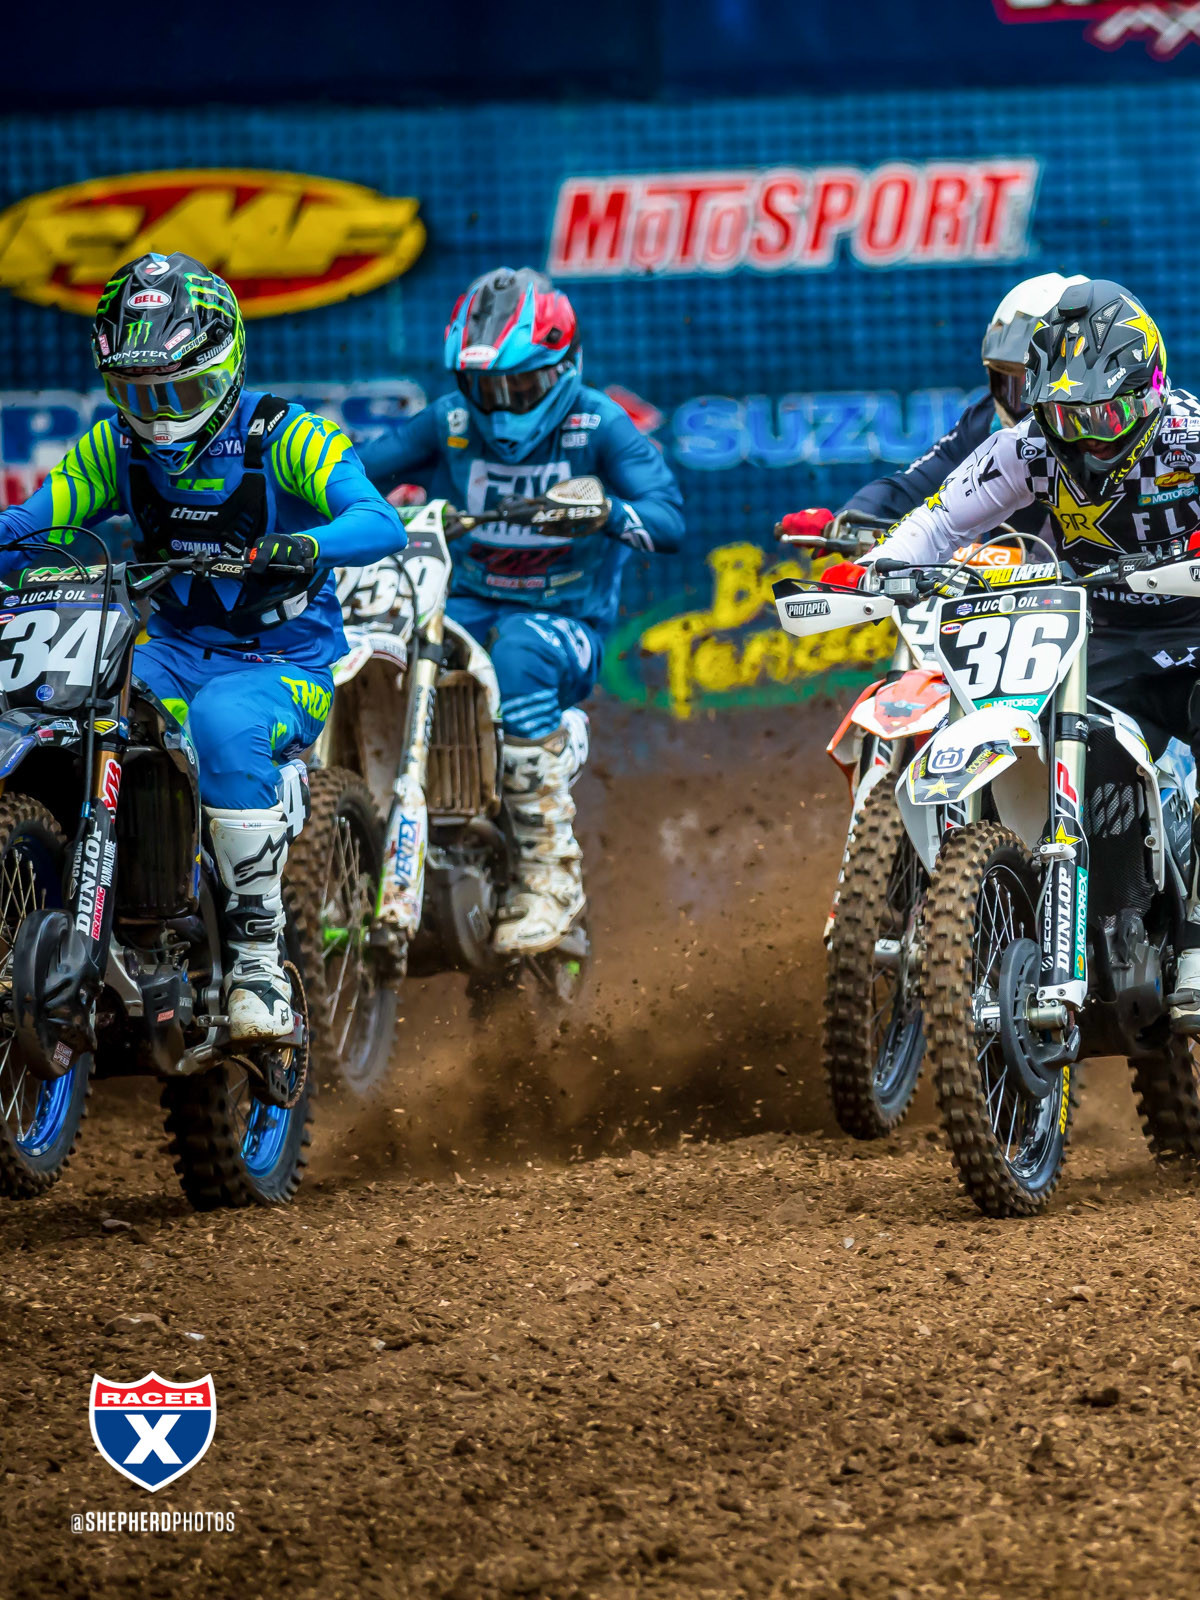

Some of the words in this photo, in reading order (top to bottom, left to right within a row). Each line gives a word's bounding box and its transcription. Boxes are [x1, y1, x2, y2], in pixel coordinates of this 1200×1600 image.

[134, 294, 164, 305] BELL
[102, 350, 169, 365] MONSTER
[1107, 368, 1127, 388] Airoh
[267, 409, 286, 432] thor
[674, 388, 985, 469] SUZU
[1161, 430, 1200, 444] WPS
[225, 440, 246, 455] YA
[1152, 487, 1199, 504] MOTOREX
[170, 506, 219, 521] thor
[181, 540, 221, 554] YAMAHA
[212, 562, 243, 574] ARC
[21, 589, 63, 604] LUCAS
[64, 590, 86, 601] OIL
[1017, 596, 1039, 608] OIL
[788, 600, 829, 617] PROTAPER
[0, 609, 121, 693] 34
[954, 613, 1069, 699] 36
[992, 698, 1039, 709] MOTOREX
[394, 813, 419, 888] VERTEX
[100, 838, 117, 888] YAMALUBE
[91, 886, 106, 941] BRAKING
[1056, 866, 1072, 974] DUNLOP
[1076, 875, 1088, 952] MOTOREX
